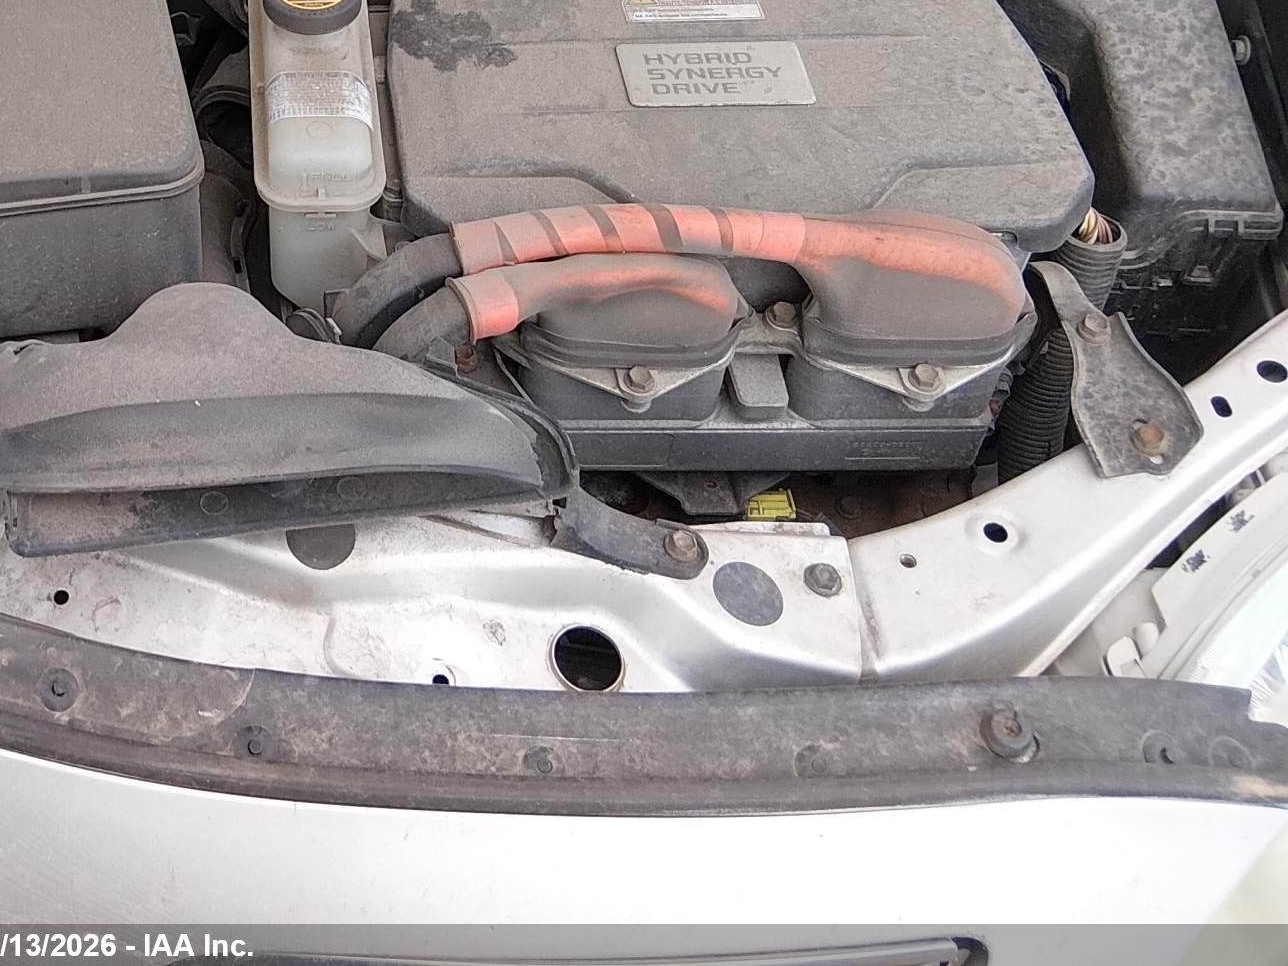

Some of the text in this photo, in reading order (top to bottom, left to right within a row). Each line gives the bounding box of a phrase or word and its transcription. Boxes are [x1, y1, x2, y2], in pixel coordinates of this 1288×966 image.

[643, 52, 752, 66] HYBRID
[647, 66, 783, 81] SYNERGY
[651, 82, 742, 95] DRIVE
